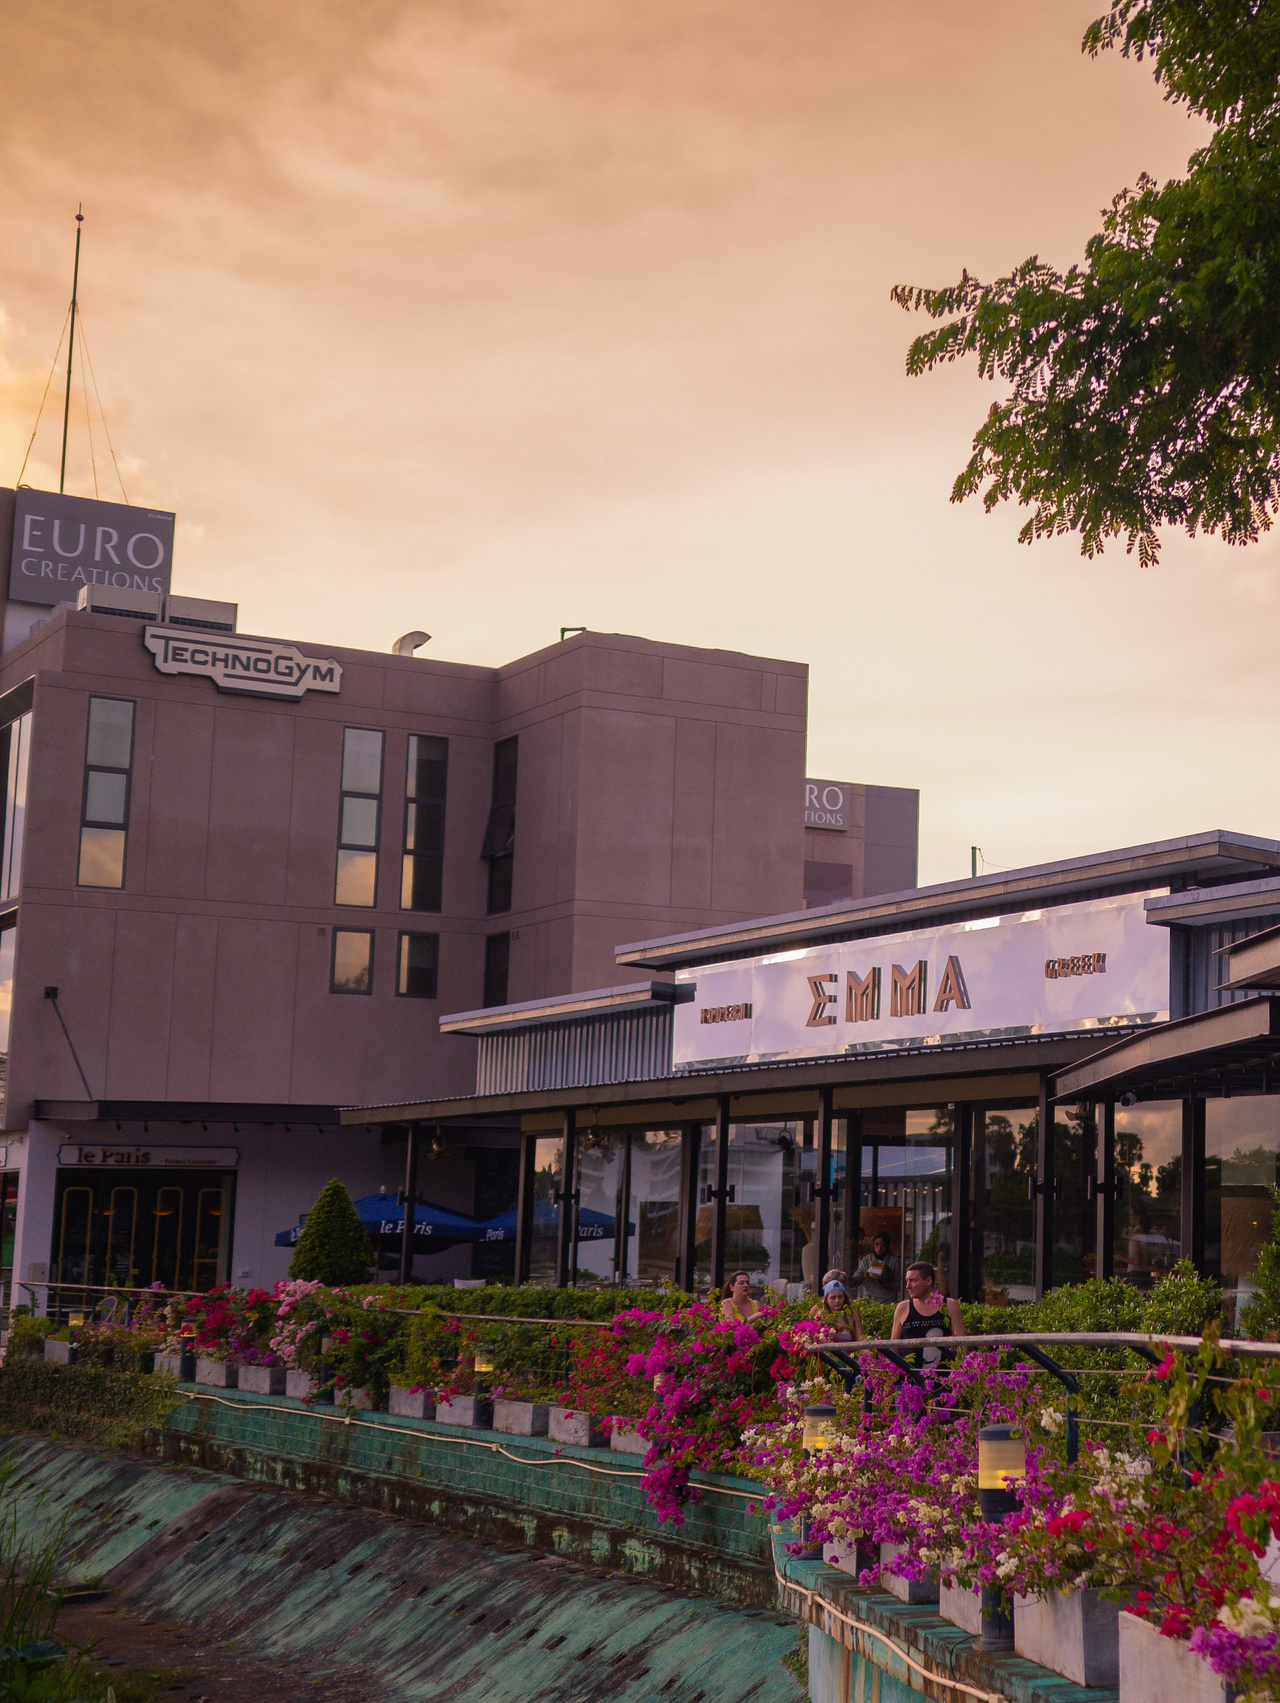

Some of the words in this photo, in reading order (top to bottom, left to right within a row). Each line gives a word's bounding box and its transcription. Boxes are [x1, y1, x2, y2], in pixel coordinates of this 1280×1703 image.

[22, 514, 164, 570] EURO
[21, 558, 162, 593] CREATIONS
[805, 784, 843, 810] RO
[805, 810, 843, 825] TIONS
[76, 1147, 96, 1163] le
[100, 1148, 151, 1164] Paris
[380, 1220, 393, 1234] le
[395, 1220, 433, 1235] Pris
[485, 1227, 505, 1241] Paris
[577, 1224, 604, 1237] aris
